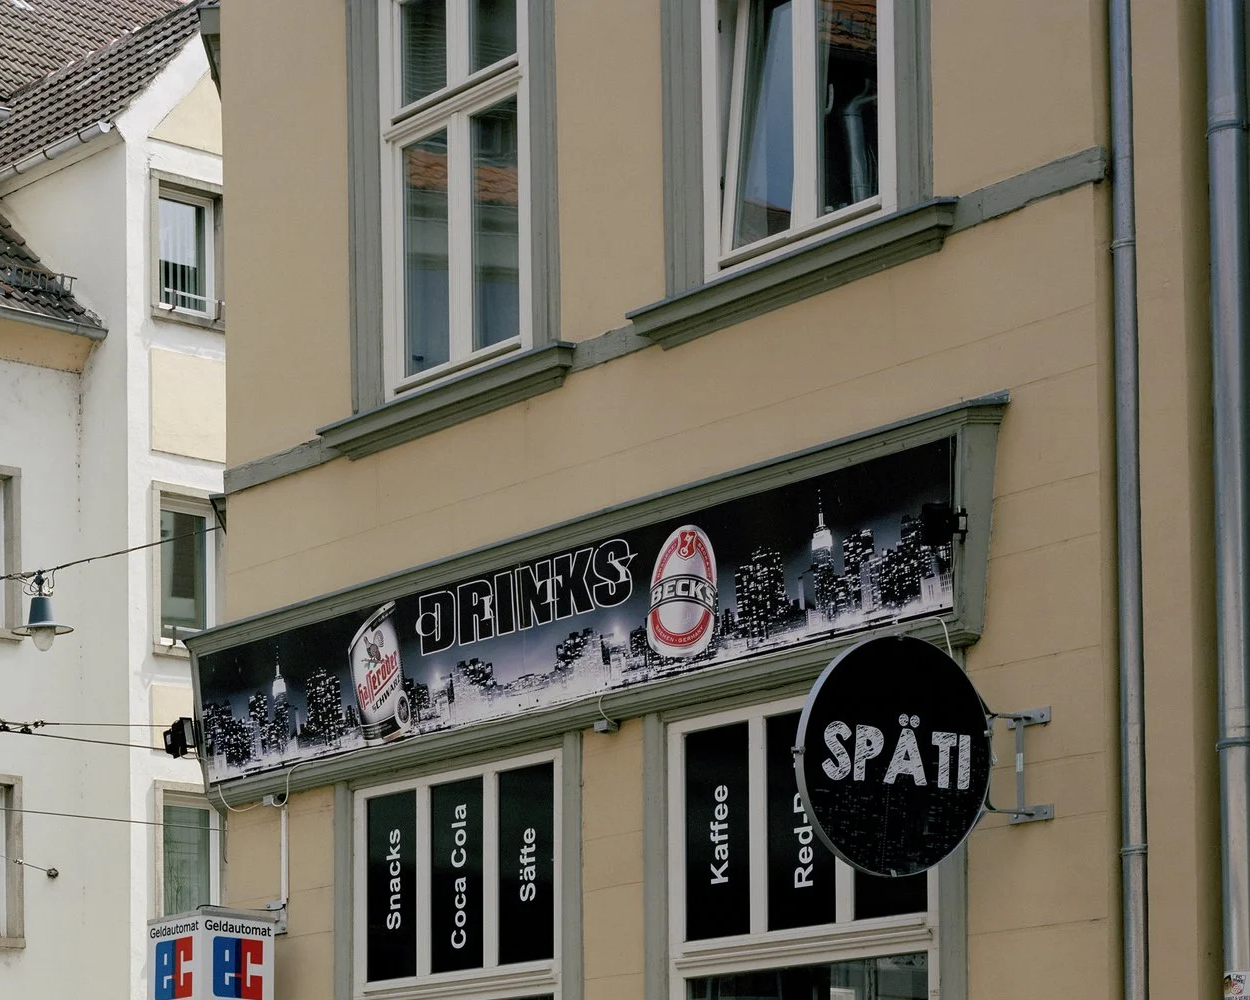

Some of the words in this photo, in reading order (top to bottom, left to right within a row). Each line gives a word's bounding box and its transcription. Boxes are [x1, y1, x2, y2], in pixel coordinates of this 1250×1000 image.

[419, 539, 633, 656] DRINKS
[651, 579, 714, 610] BECK'S
[821, 713, 971, 790] SPÄTI
[451, 803, 467, 868] Cola
[519, 827, 536, 902] Säfte
[709, 784, 729, 885] Kaffee
[386, 828, 401, 930] Snacks
[451, 876, 467, 949] Coca
[150, 920, 199, 939] Geldautomat
[204, 919, 272, 937] Geldautomat
